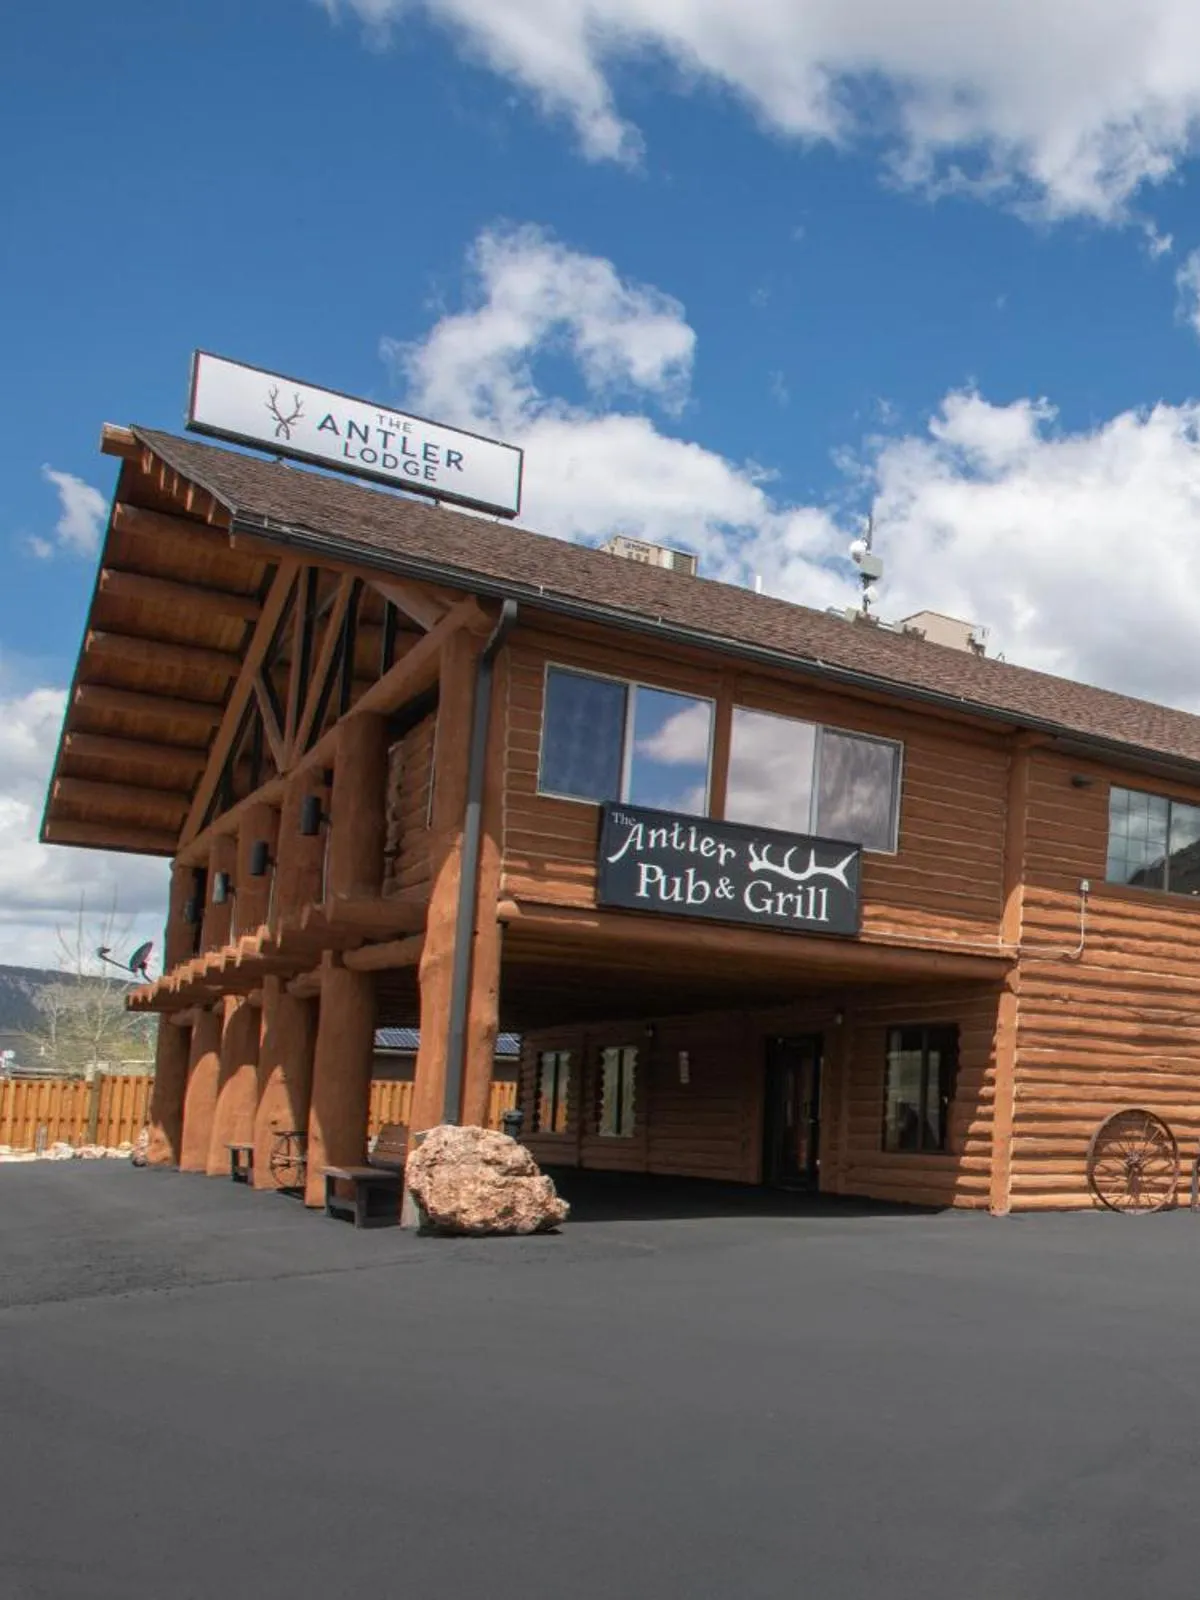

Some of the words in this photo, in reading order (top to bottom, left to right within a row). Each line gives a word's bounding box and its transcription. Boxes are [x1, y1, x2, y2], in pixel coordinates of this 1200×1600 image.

[317, 413, 464, 472] ANTLER
[376, 413, 413, 433] THE
[343, 441, 438, 481] LODGE
[611, 811, 636, 827] The
[607, 822, 736, 866] Antler
[635, 862, 710, 905] Pub
[715, 876, 735, 900] &
[743, 880, 829, 922] Grill
